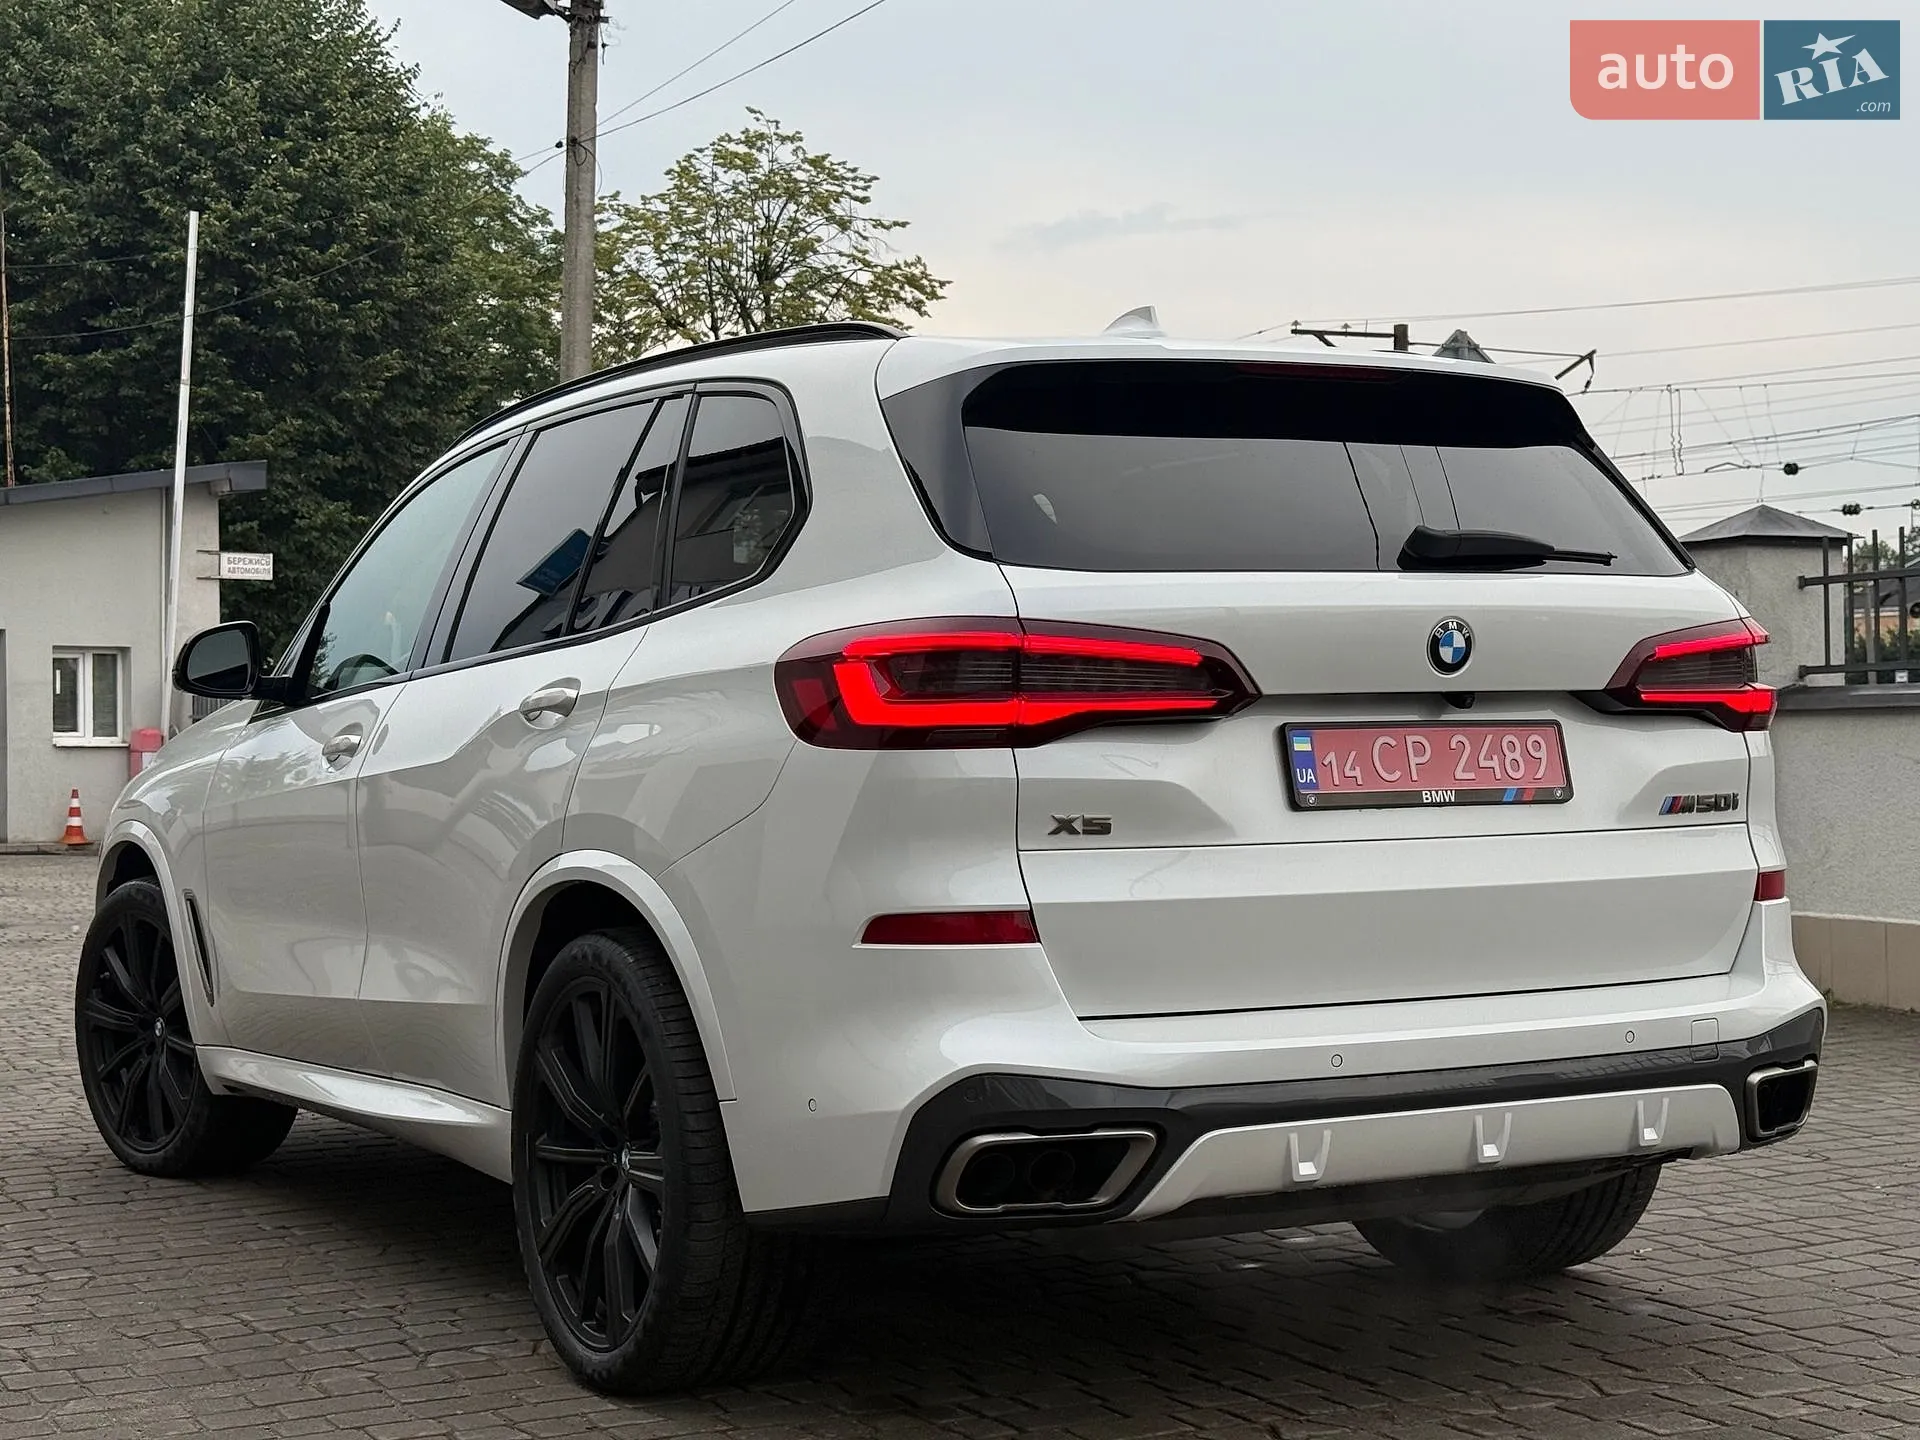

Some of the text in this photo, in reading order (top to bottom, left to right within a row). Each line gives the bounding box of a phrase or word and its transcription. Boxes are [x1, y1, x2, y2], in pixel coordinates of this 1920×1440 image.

[1321, 733, 1548, 786] 14 CP 2489
[1296, 768, 1317, 784] UA
[1422, 790, 1456, 803] BMW
[1047, 814, 1112, 836] X5
